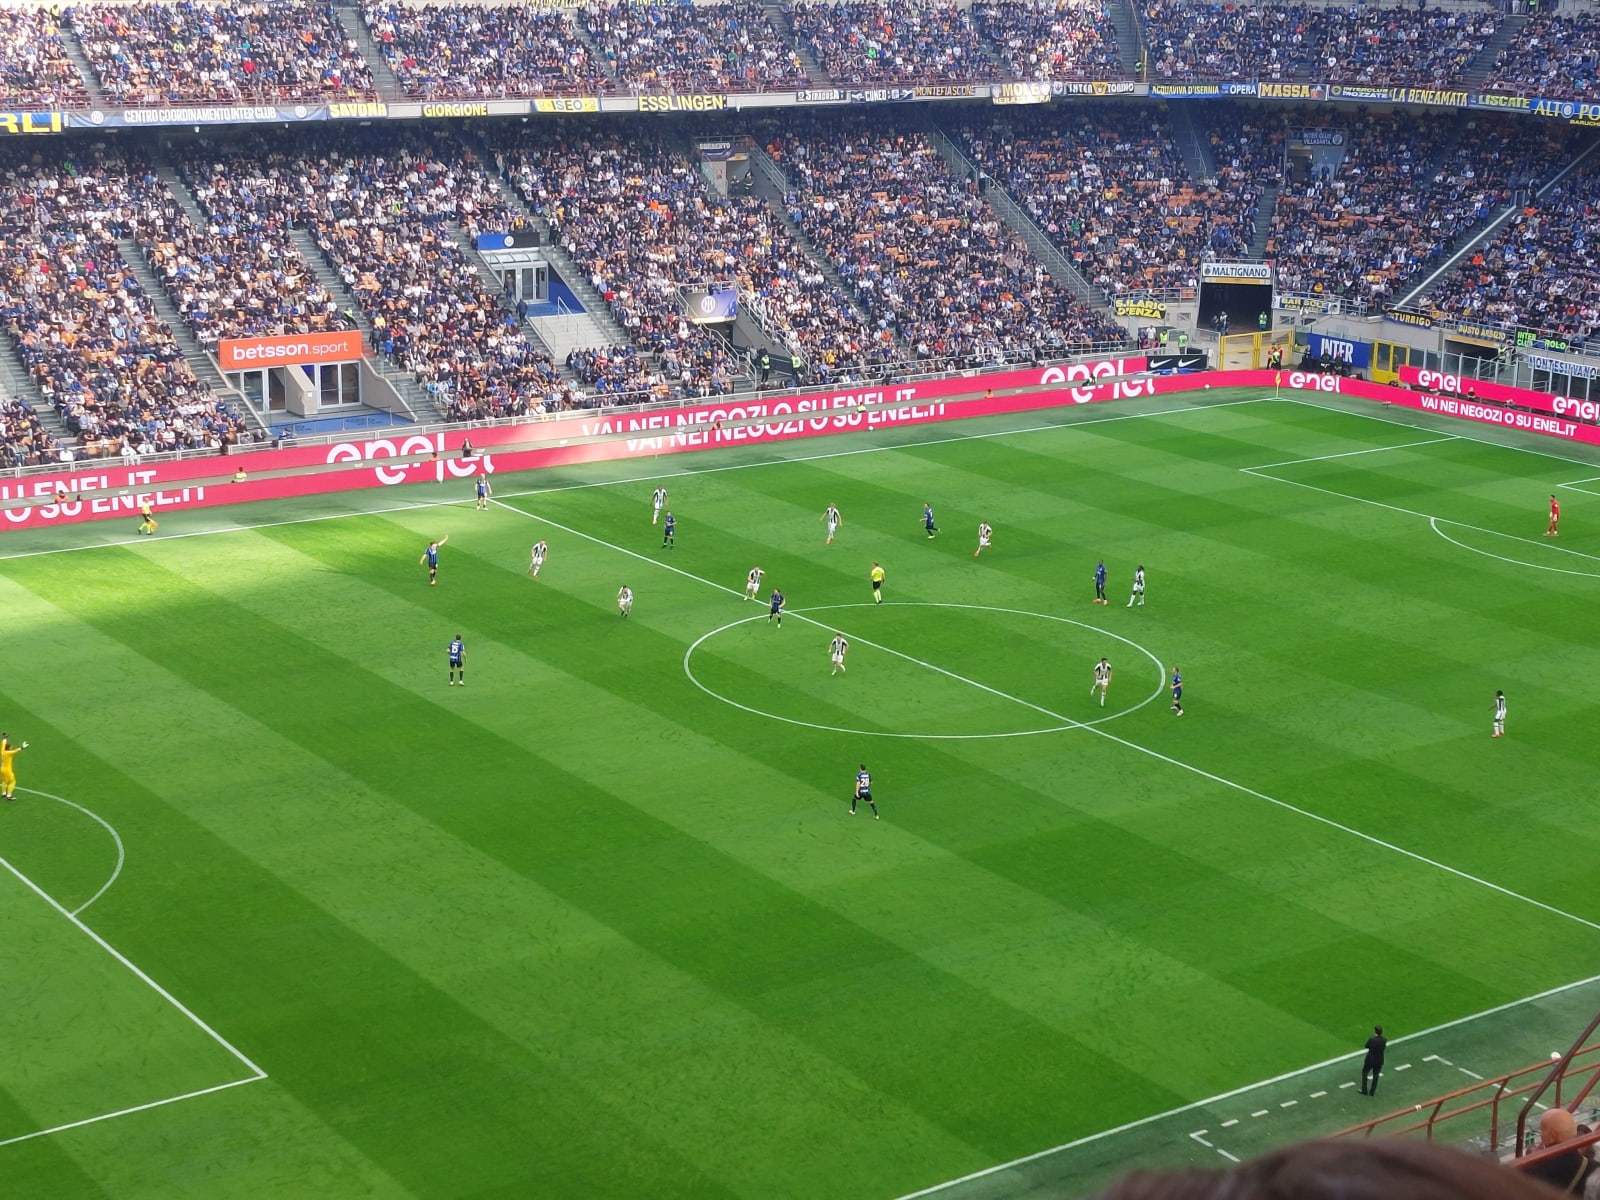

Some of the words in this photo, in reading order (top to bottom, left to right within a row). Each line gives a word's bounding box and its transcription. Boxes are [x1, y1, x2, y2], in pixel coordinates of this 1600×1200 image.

[1229, 85, 1257, 95] OPERA
[1261, 84, 1310, 98] MASSA
[1392, 88, 1406, 102] LA
[1408, 90, 1468, 107] BENEAMATA
[551, 99, 583, 111] ISEO
[1478, 94, 1530, 109] LISCATE
[124, 111, 158, 124] CENTRO
[159, 109, 230, 123] COORDINAMENTO
[231, 107, 255, 121] INTER
[256, 106, 276, 121] CLUB
[329, 103, 387, 118] SAVONA
[423, 103, 487, 118] GIORGIONE
[1212, 266, 1268, 278] MALTIGNANO
[1115, 299, 1167, 312] S.ILARIO
[1116, 307, 1162, 319] D'ENZA
[1458, 325, 1480, 335] BUSTO
[1517, 331, 1537, 340] INTER
[233, 341, 349, 361] betsson.sport
[1320, 337, 1354, 363] INTER
[1290, 371, 1340, 393] enel
[1418, 369, 1462, 394] enel
[1552, 396, 1600, 421] enel
[1421, 395, 1438, 410] VAI
[1439, 399, 1459, 413] NEI
[1460, 402, 1502, 423] NEGOZI
[1504, 412, 1514, 424] O
[1516, 414, 1533, 431] SU
[1533, 418, 1578, 438] ENEL.IT
